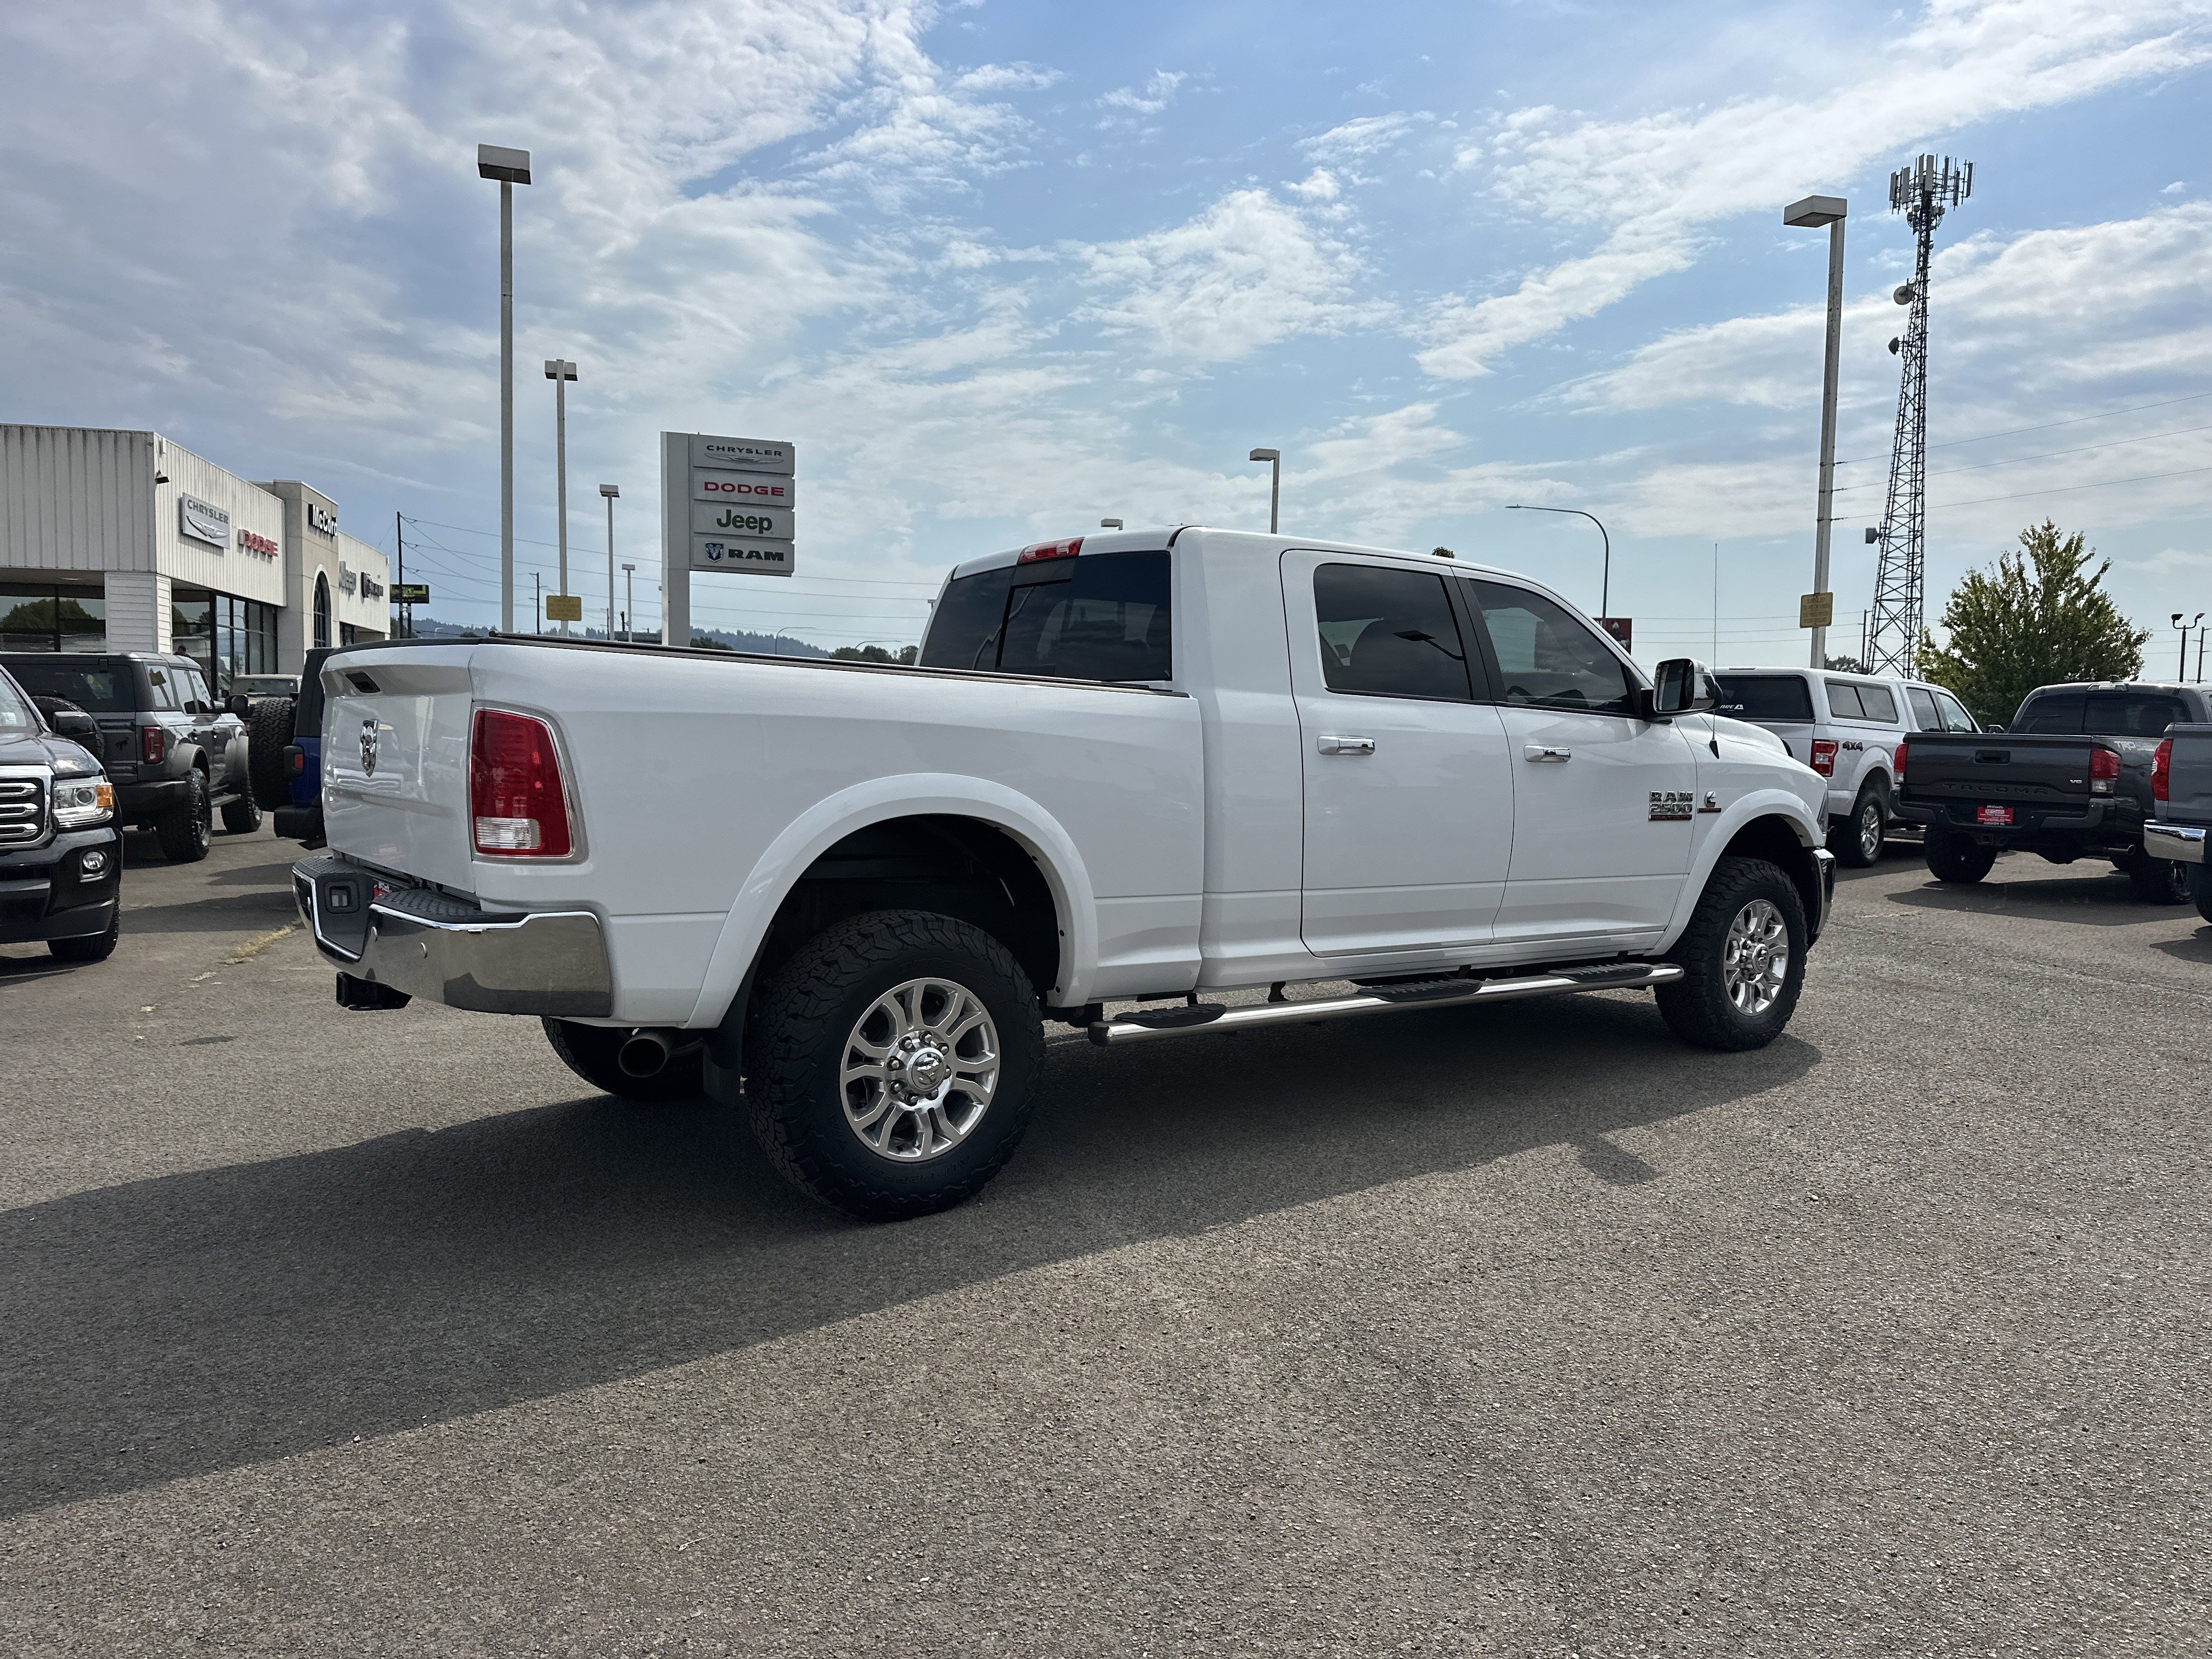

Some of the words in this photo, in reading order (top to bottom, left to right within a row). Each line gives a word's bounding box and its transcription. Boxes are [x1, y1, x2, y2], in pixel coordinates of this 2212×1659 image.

[706, 445, 782, 456] CHRYSLER
[704, 481, 784, 496] DODGE
[187, 499, 229, 524] CHRYSLER
[312, 504, 338, 536] McCord
[716, 509, 772, 534] Jeep
[242, 529, 278, 556] DODGE
[728, 549, 784, 561] RAM
[1943, 783, 2047, 795] TACOMA
[1649, 791, 1693, 802] RAM
[1649, 802, 1692, 814] 2500
